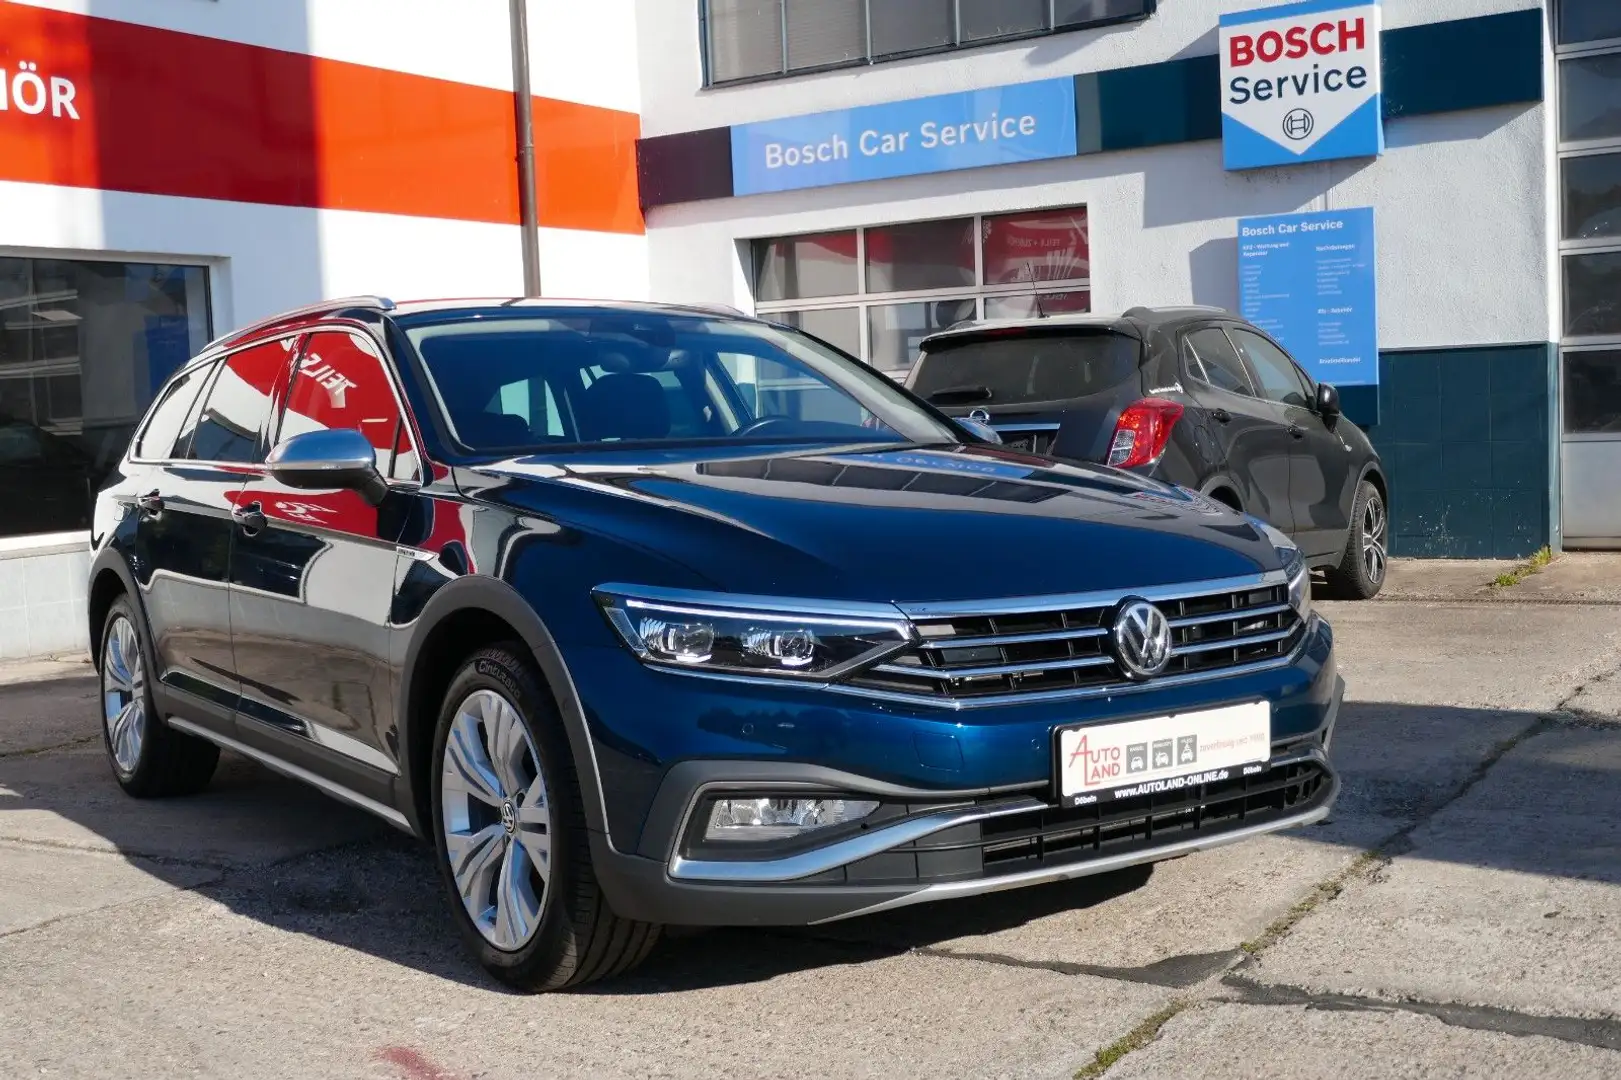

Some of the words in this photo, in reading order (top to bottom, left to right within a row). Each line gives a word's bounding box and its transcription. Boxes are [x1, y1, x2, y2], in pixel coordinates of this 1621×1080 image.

[1229, 17, 1365, 68] BOSCH
[0, 60, 80, 120] ÖR
[1229, 64, 1367, 105] Service
[765, 134, 848, 169] Bosch
[859, 129, 910, 157] Car
[920, 112, 1036, 149] Service
[1242, 224, 1275, 237] Bosch
[1278, 223, 1298, 234] Car
[1300, 219, 1344, 232] Service
[1114, 770, 1229, 799] www.AUTOLAND-ONLINE.de
